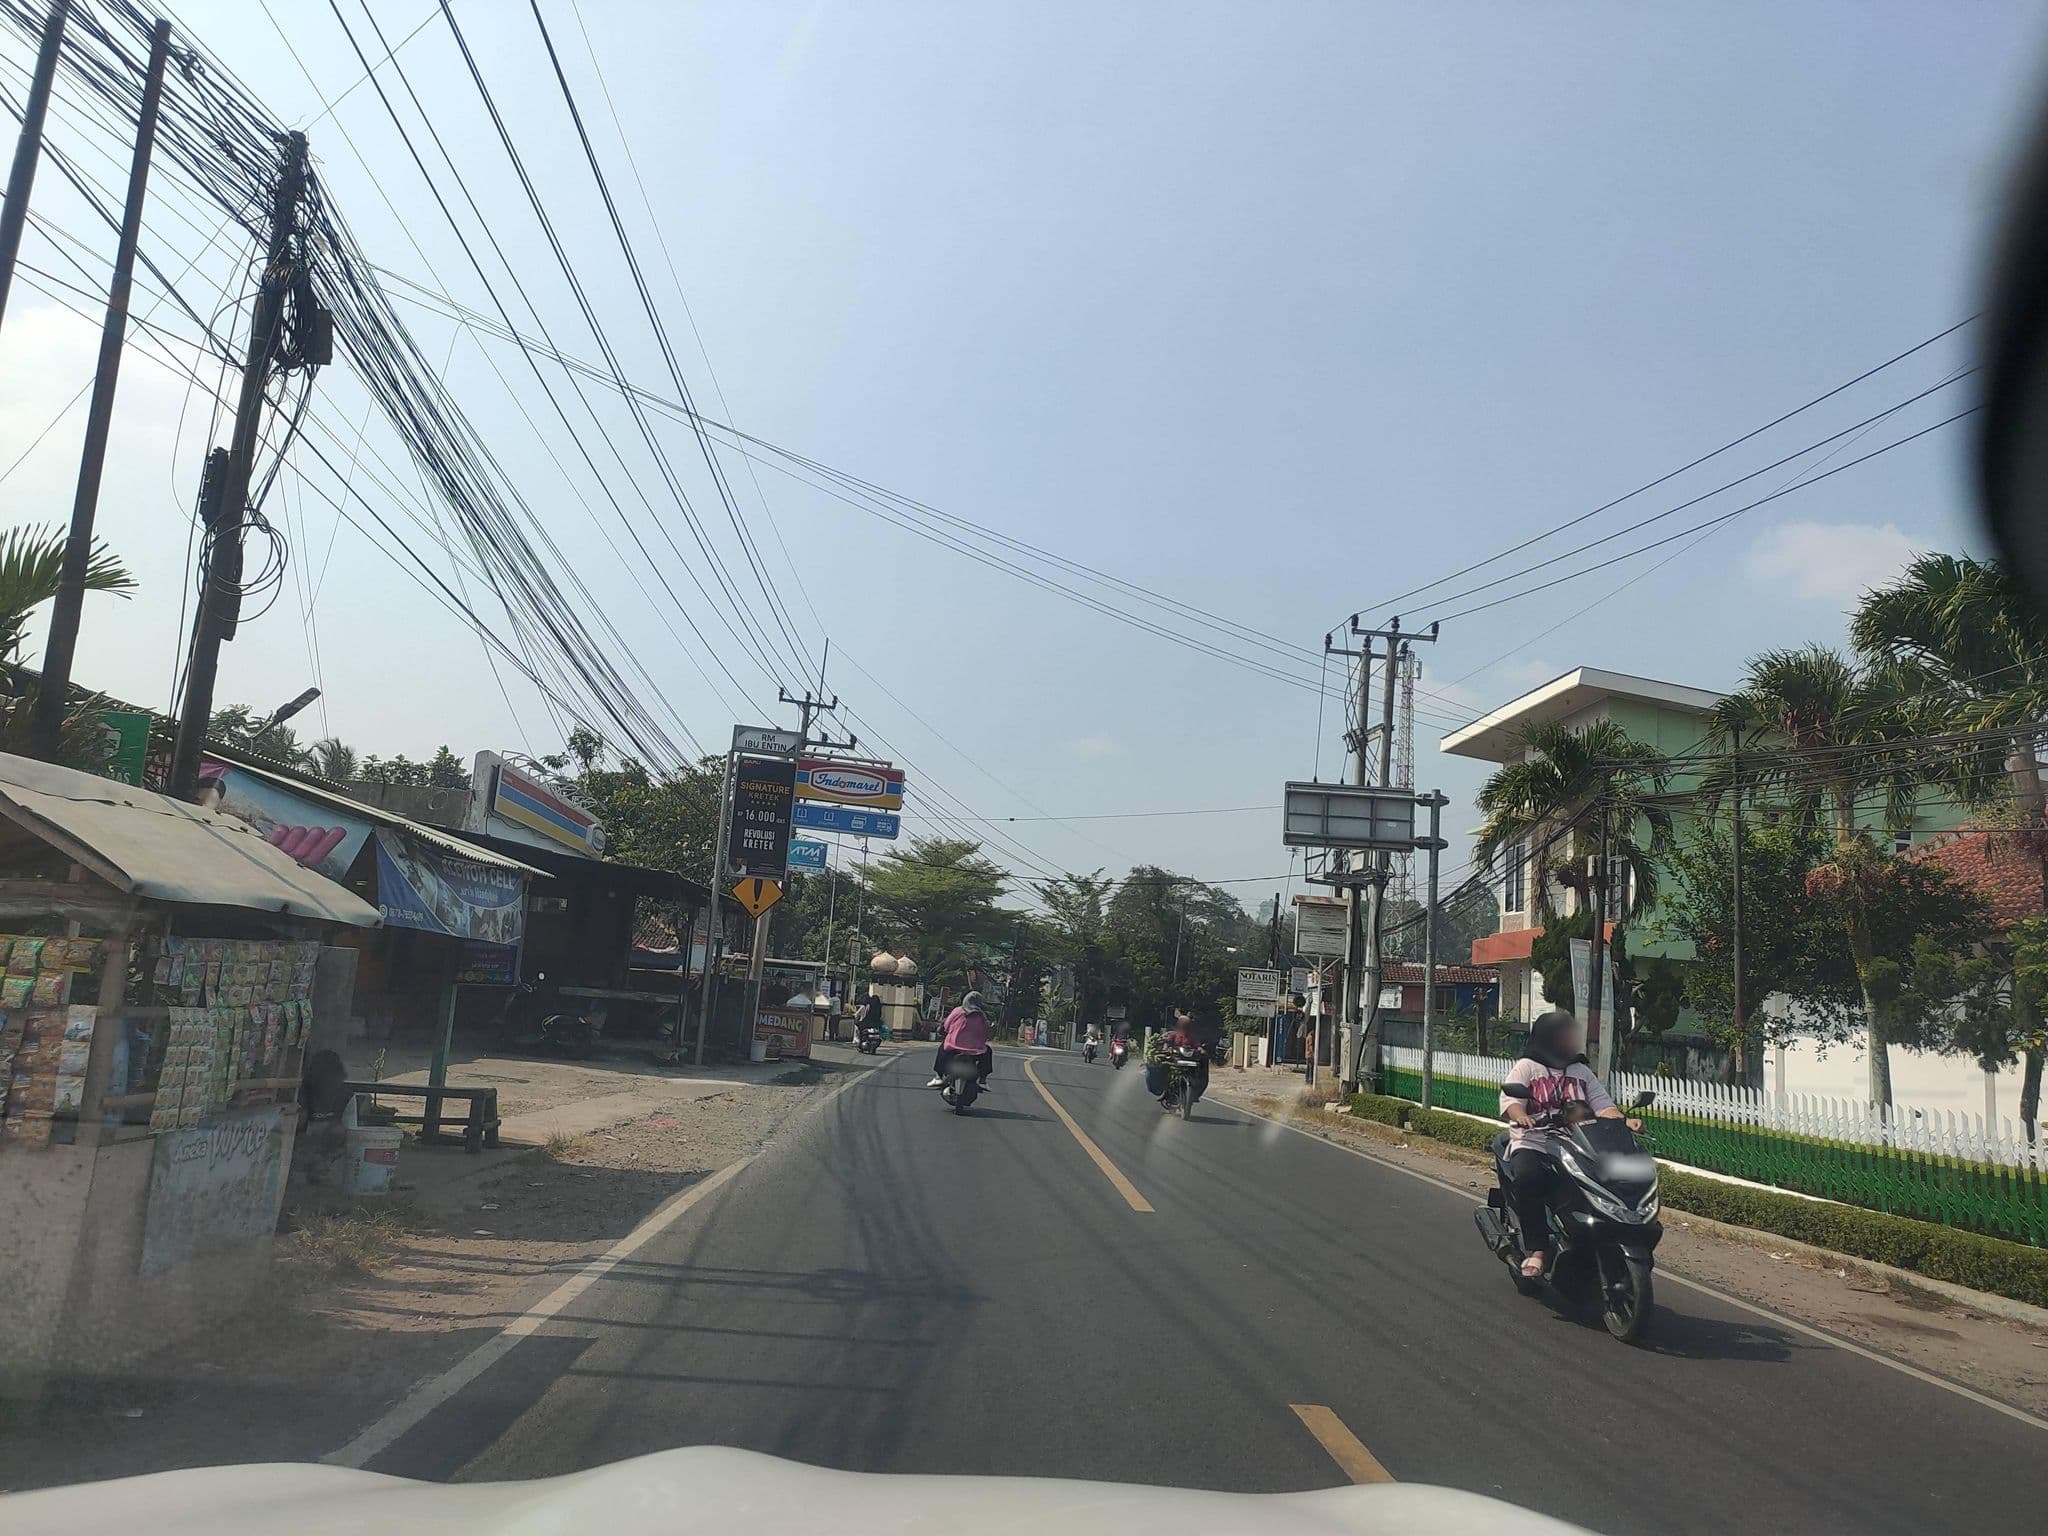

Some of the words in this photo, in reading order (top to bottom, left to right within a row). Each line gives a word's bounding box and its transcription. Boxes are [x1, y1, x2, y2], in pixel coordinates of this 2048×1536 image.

[761, 733, 776, 742] RM
[744, 740, 760, 749] IBU
[762, 742, 787, 752] ENTIN
[740, 781, 791, 795] SIGNATURE
[815, 773, 881, 792] Indomaret
[748, 792, 780, 801] KRETEK
[745, 809, 776, 823] 16.000
[744, 829, 775, 840] REVOLUSI
[743, 838, 774, 851] KRETEK
[790, 846, 820, 856] ATM
[490, 868, 514, 890] CELL
[1239, 972, 1277, 982] NOTARIS
